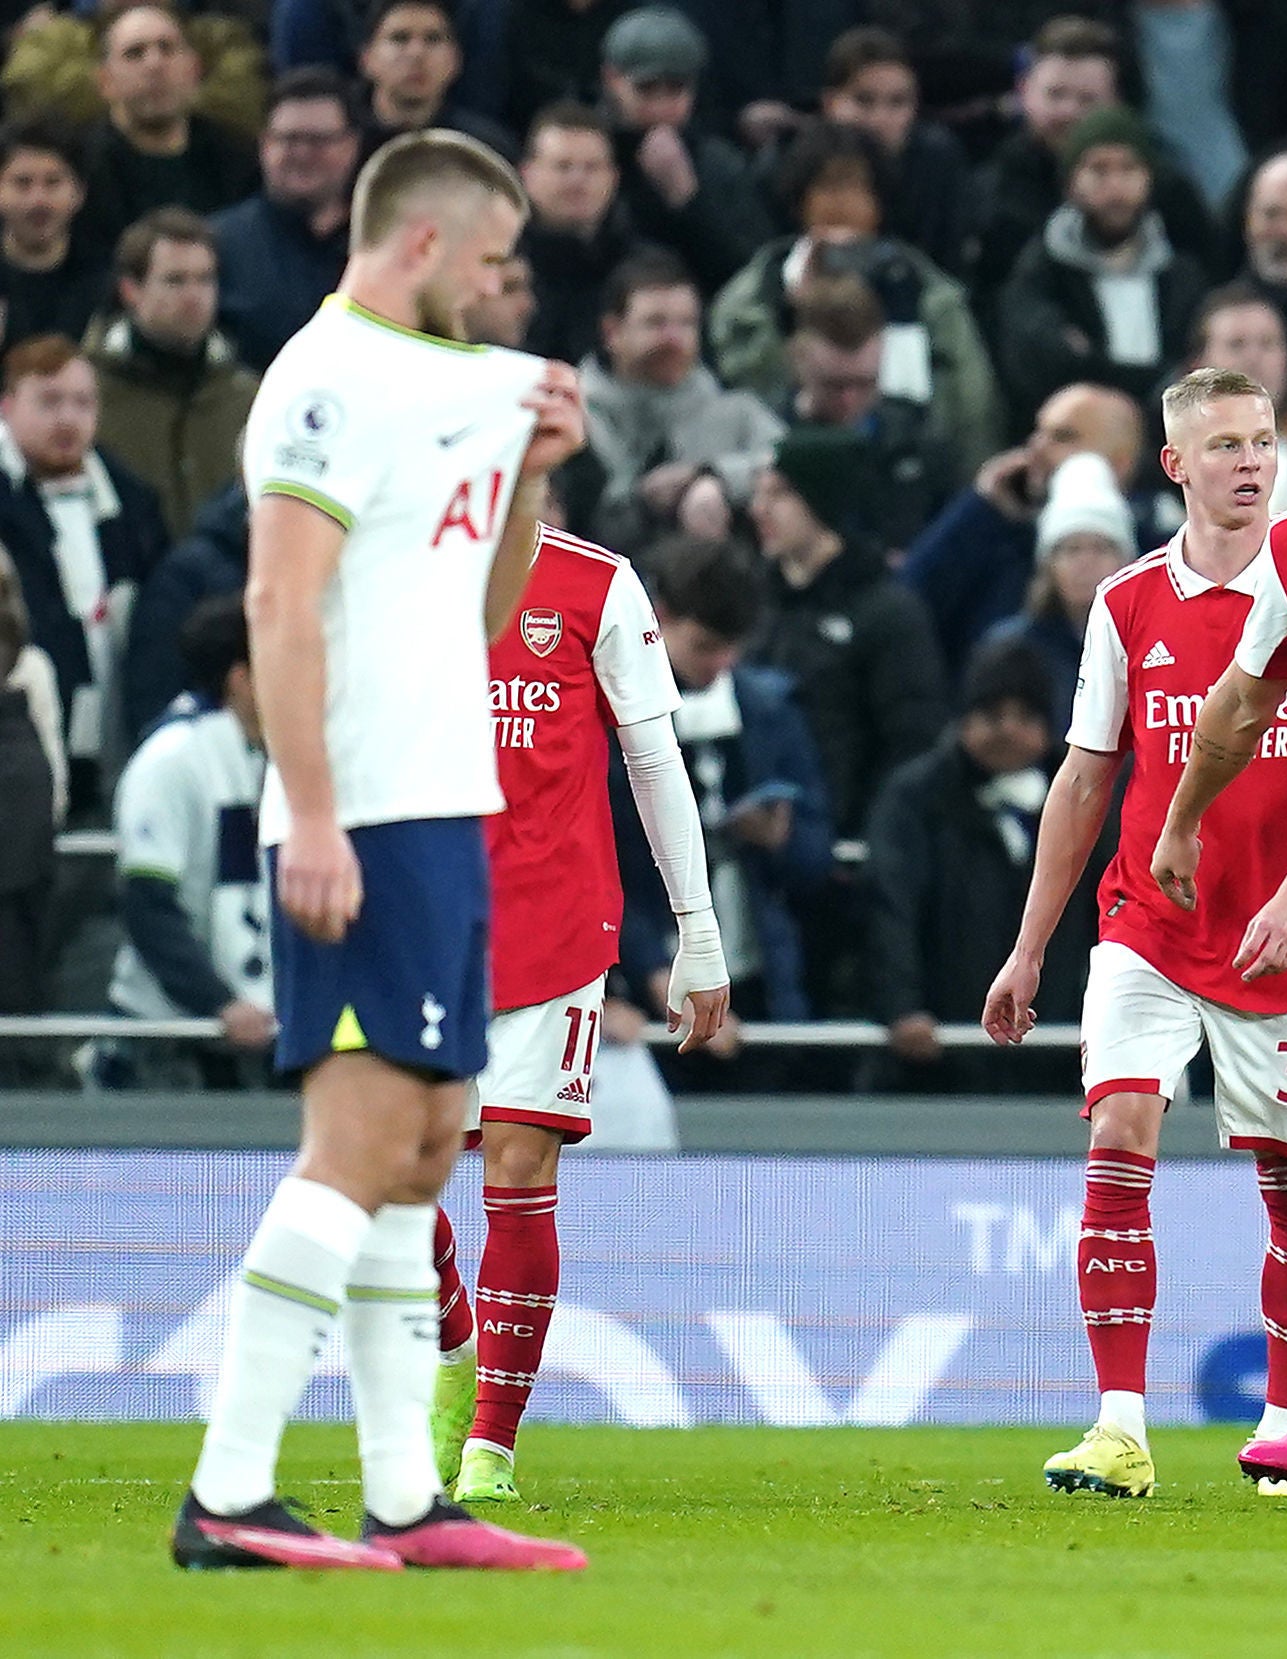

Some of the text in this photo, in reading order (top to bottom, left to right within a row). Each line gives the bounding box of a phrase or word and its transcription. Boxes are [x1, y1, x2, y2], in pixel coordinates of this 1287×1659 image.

[431, 470, 503, 548] AI
[560, 1006, 597, 1075] 11
[1085, 1257, 1147, 1275] AFC
[483, 1319, 534, 1338] AFC
